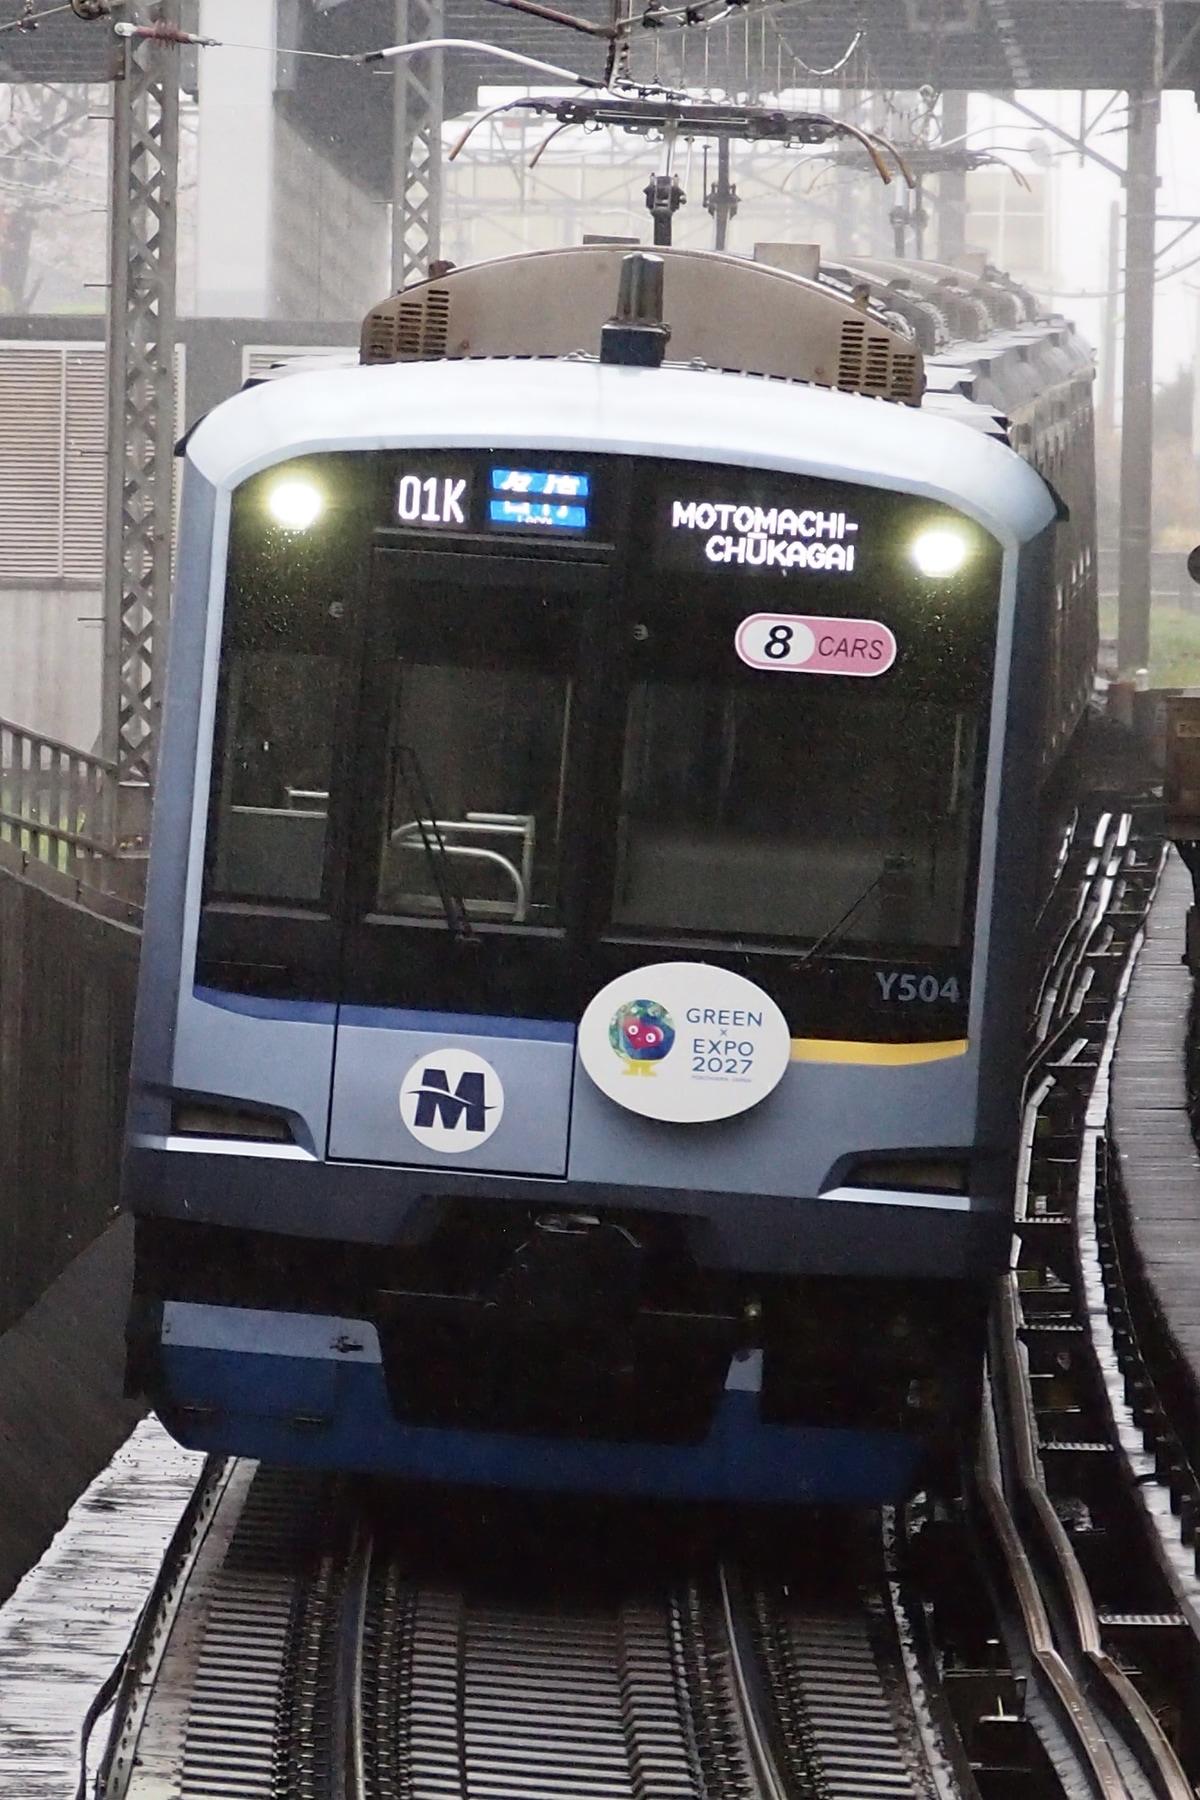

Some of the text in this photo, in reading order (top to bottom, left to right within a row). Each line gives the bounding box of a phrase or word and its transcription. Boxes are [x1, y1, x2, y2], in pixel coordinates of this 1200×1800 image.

[672, 500, 859, 539] MOTOMACHI-
[705, 532, 855, 571] CHŪKAGAI
[763, 625, 884, 660] 8 CARS
[875, 971, 960, 1003] Y504
[686, 1008, 763, 1027] GREEN
[693, 1038, 754, 1057] EXPO
[692, 1057, 753, 1074] 2027
